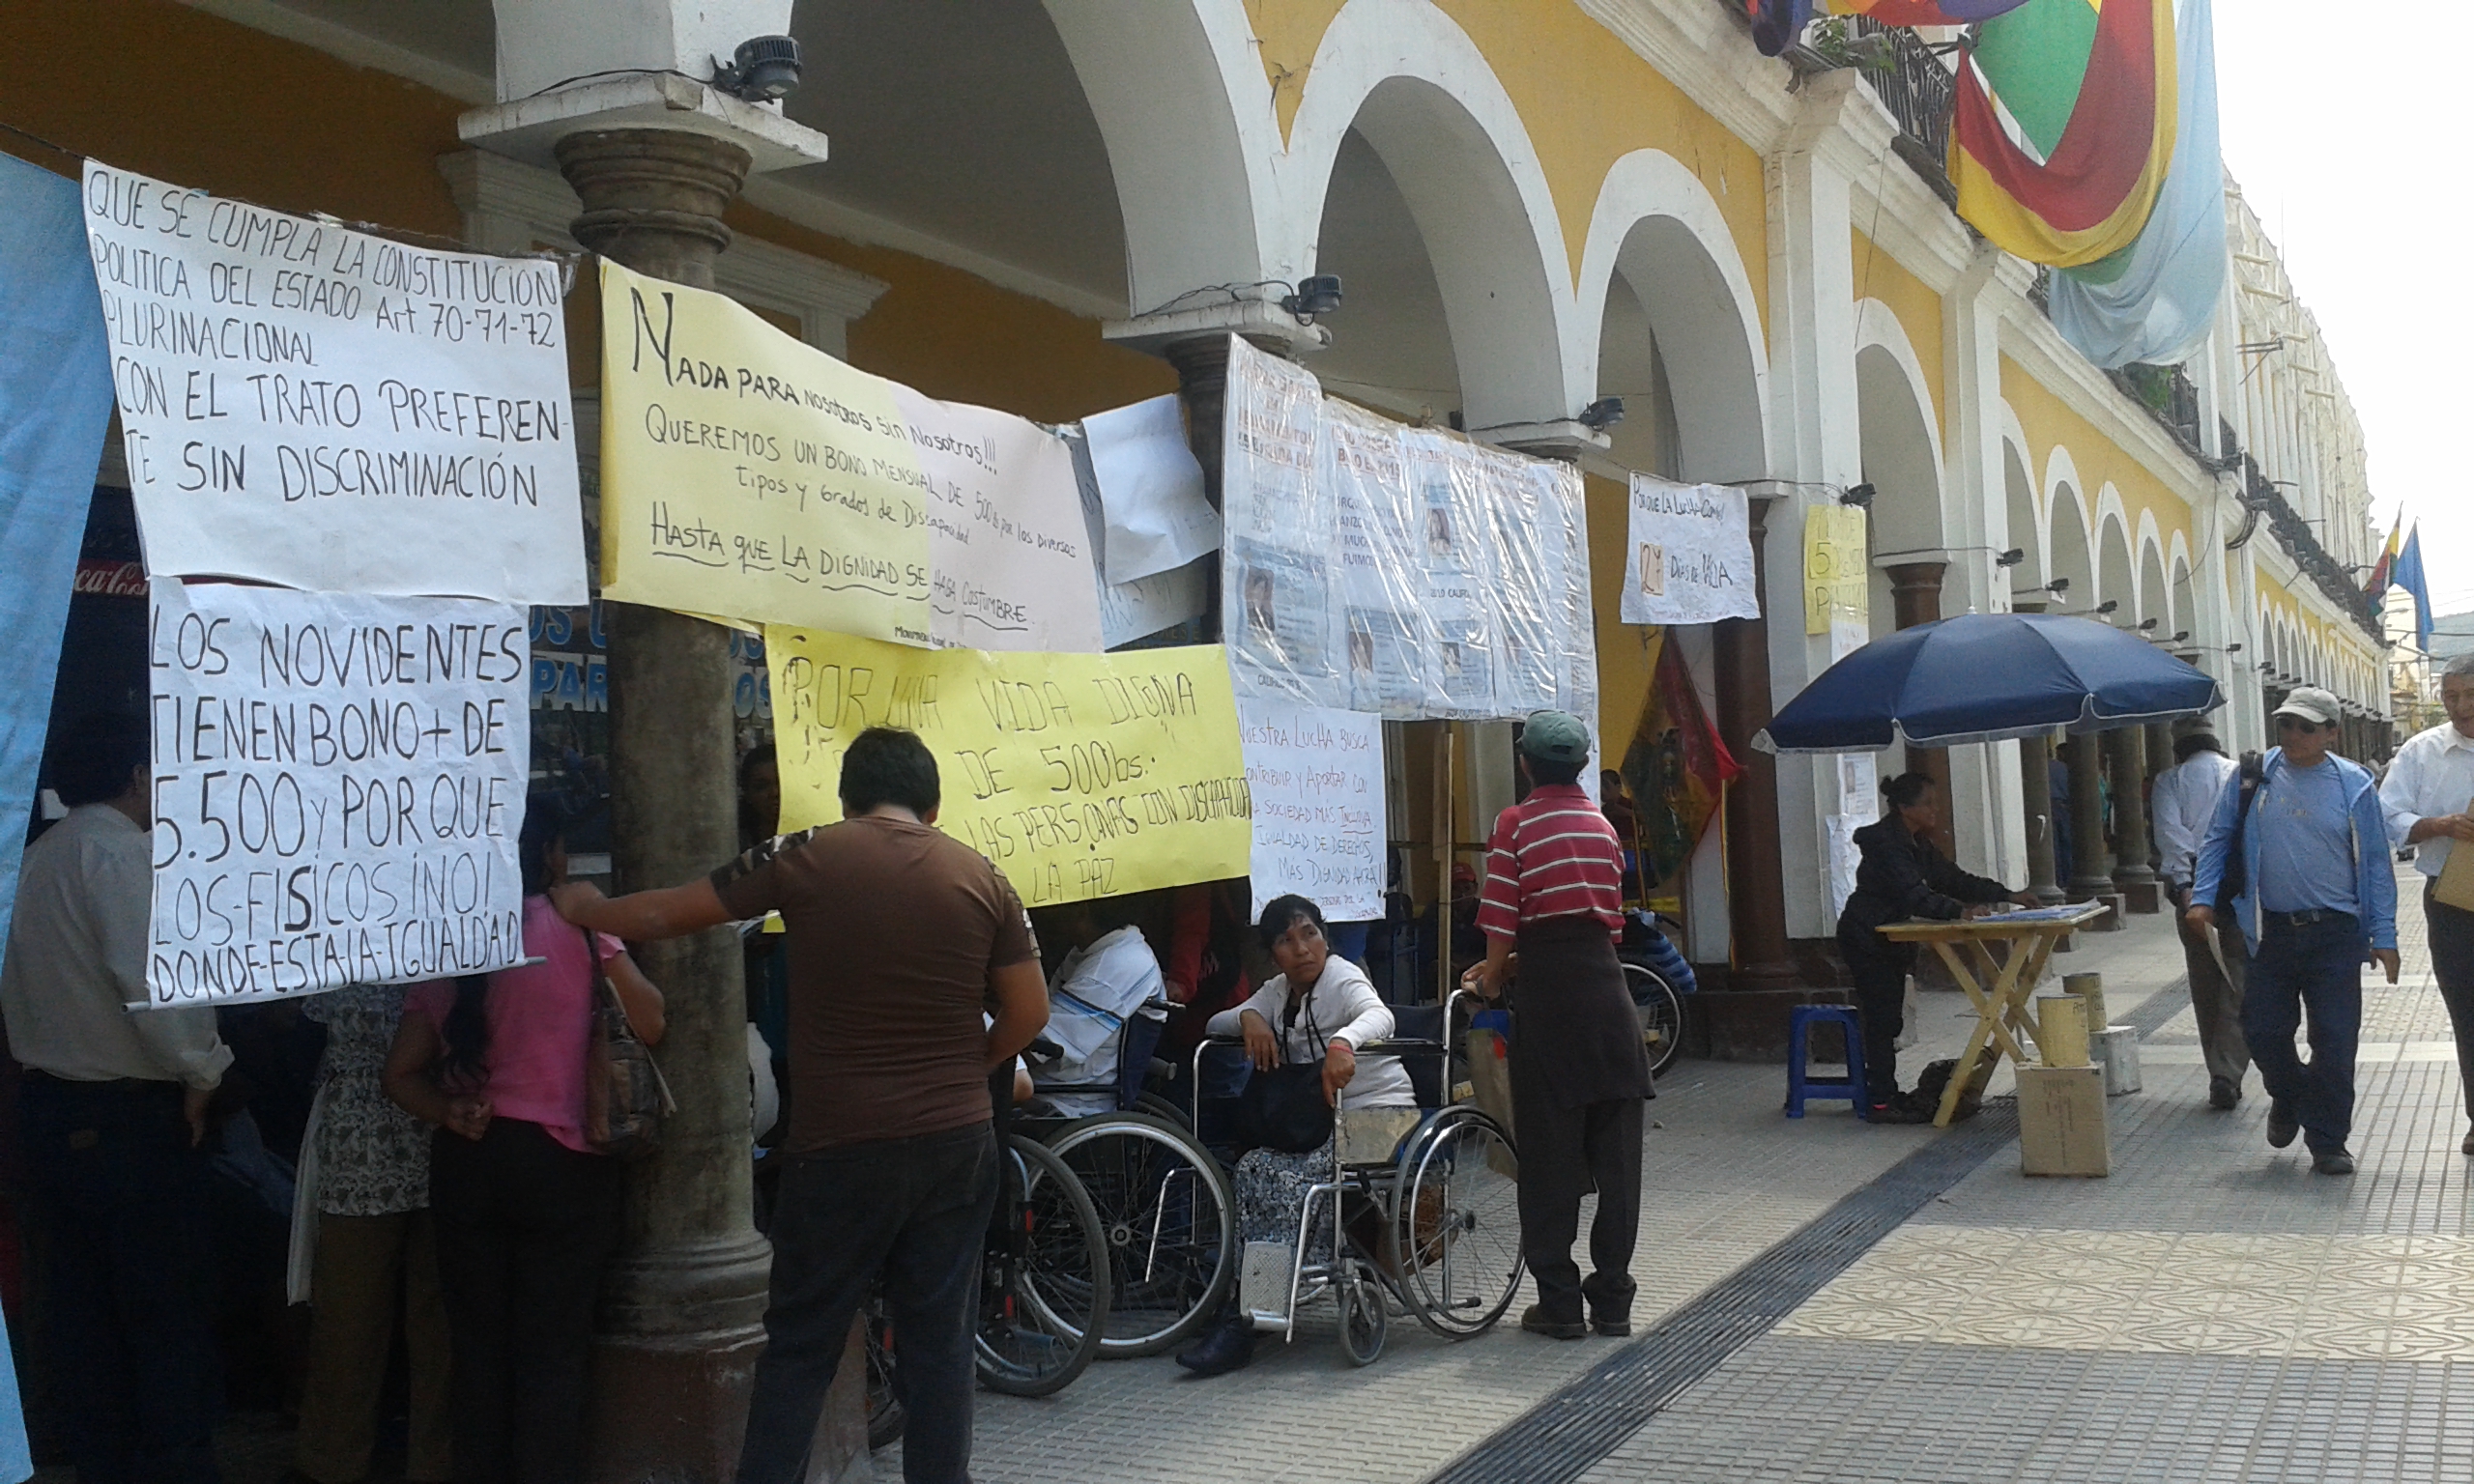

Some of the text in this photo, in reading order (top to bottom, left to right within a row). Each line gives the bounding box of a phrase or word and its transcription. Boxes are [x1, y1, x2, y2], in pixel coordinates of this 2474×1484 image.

[88, 170, 150, 230] QUE
[159, 188, 200, 239] SE
[207, 200, 322, 267] CUMPLA
[332, 235, 365, 279] LA
[92, 233, 191, 300] POLITICA
[210, 262, 258, 308] DEL
[272, 270, 361, 321] ESTADO
[428, 302, 557, 349] 70-71-72
[102, 289, 319, 367] PLURINACIONAL
[630, 286, 731, 389] NADA
[737, 367, 801, 407] PARA
[116, 356, 168, 418] CON
[185, 370, 228, 421] EL
[245, 373, 361, 428] TRATO
[126, 428, 157, 485] TE
[177, 442, 245, 493] SIN
[276, 442, 538, 507] DISCRIMINACIÓN
[645, 403, 781, 463] QUEREMOS
[794, 440, 820, 467] UN
[824, 444, 868, 477] BONO
[874, 458, 943, 501] MENSUAL
[947, 480, 964, 507] DE
[877, 498, 898, 523] de
[782, 534, 811, 570] LA
[820, 549, 900, 585] DIGNIDAD
[906, 563, 929, 587] SE
[151, 604, 231, 675] LOS
[152, 694, 297, 764] TIENEN
[309, 700, 419, 766] BONO
[462, 699, 505, 756] DE
[782, 656, 875, 730] POR
[976, 677, 1073, 732] VIDA
[1092, 671, 1196, 726] DIGNA
[1294, 715, 1334, 751] LUCHA
[1339, 728, 1370, 753] BUSCA
[954, 746, 1015, 800] DE
[153, 770, 305, 870] 5.500
[1012, 794, 1140, 853] PERSONAS
[1264, 799, 1312, 824] SOCIEDAD
[1314, 835, 1328, 853] DE
[1033, 857, 1119, 903] LA PAZ
